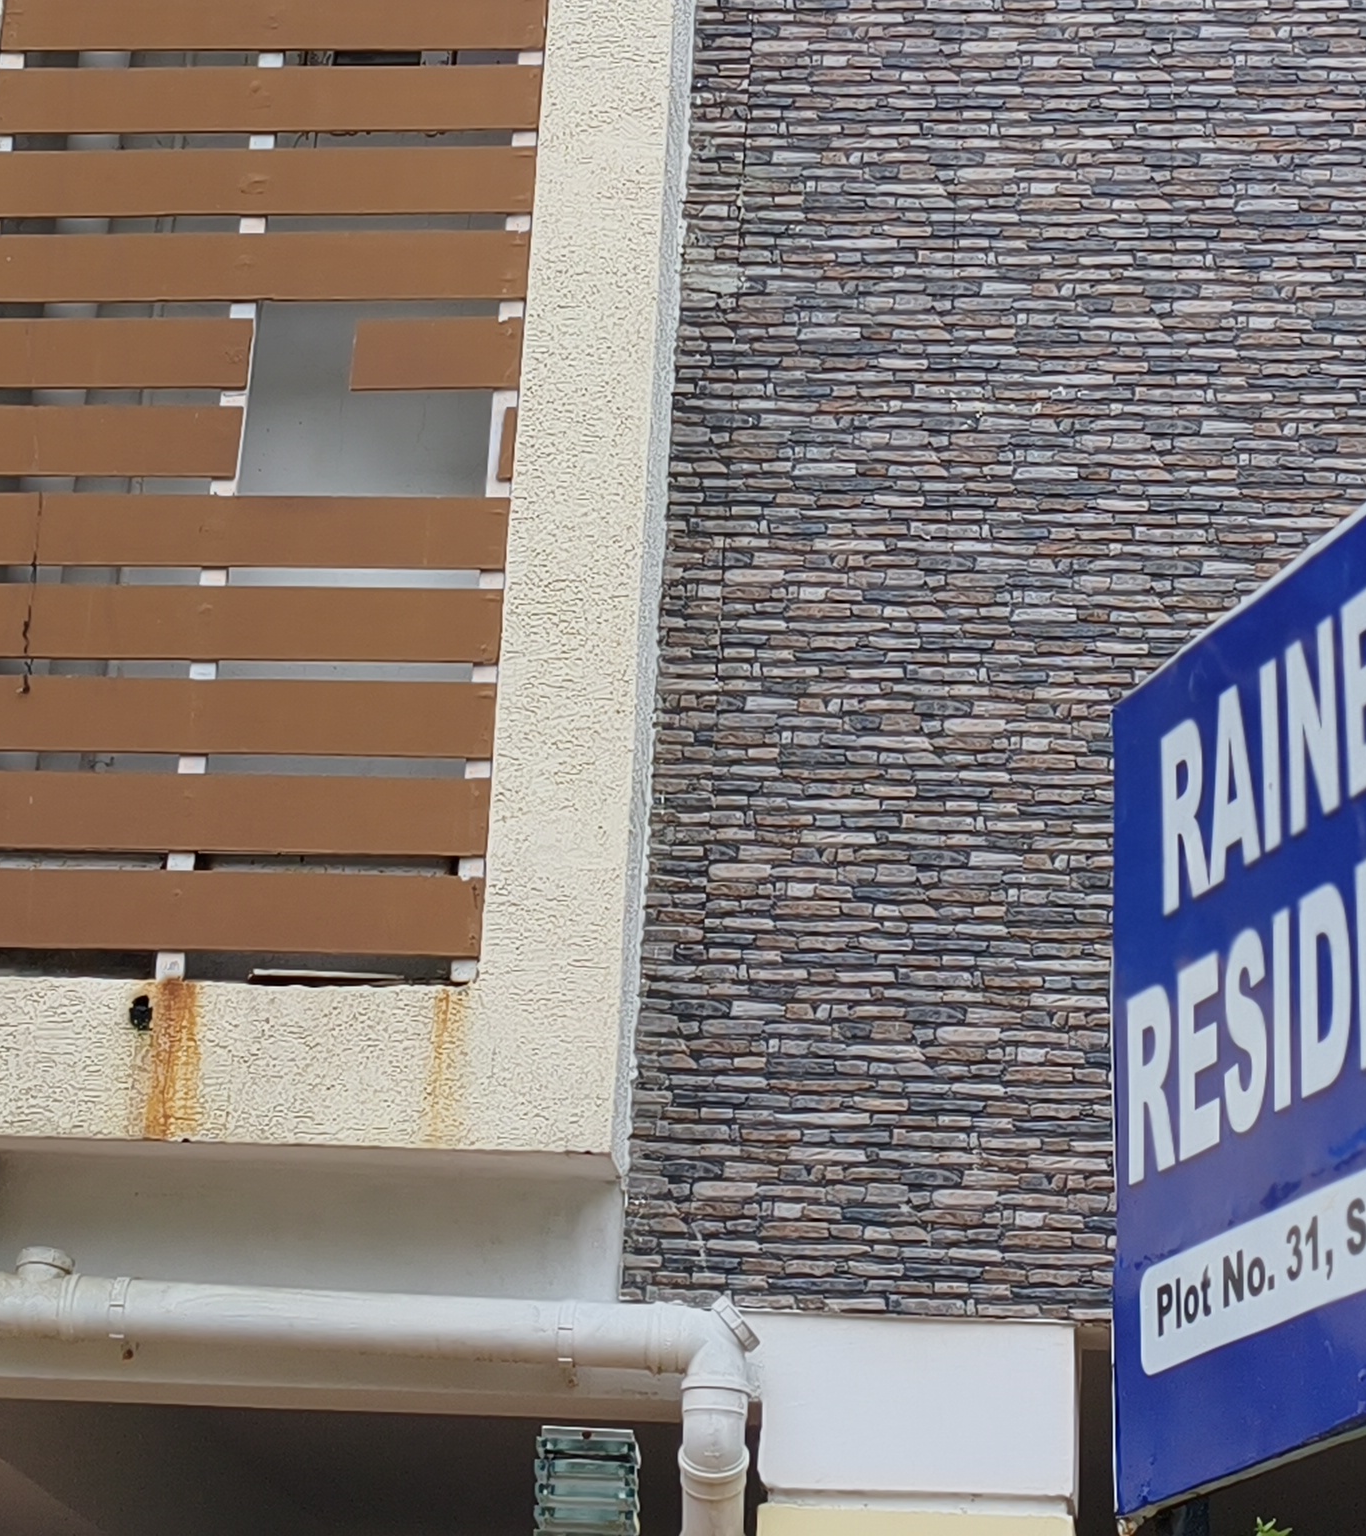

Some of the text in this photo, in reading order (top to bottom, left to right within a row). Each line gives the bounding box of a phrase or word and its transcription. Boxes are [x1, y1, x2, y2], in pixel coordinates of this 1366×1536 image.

[1156, 1265, 1212, 1337] Plot
[1221, 1249, 1275, 1308] No.
[1285, 1215, 1334, 1280] 31,
